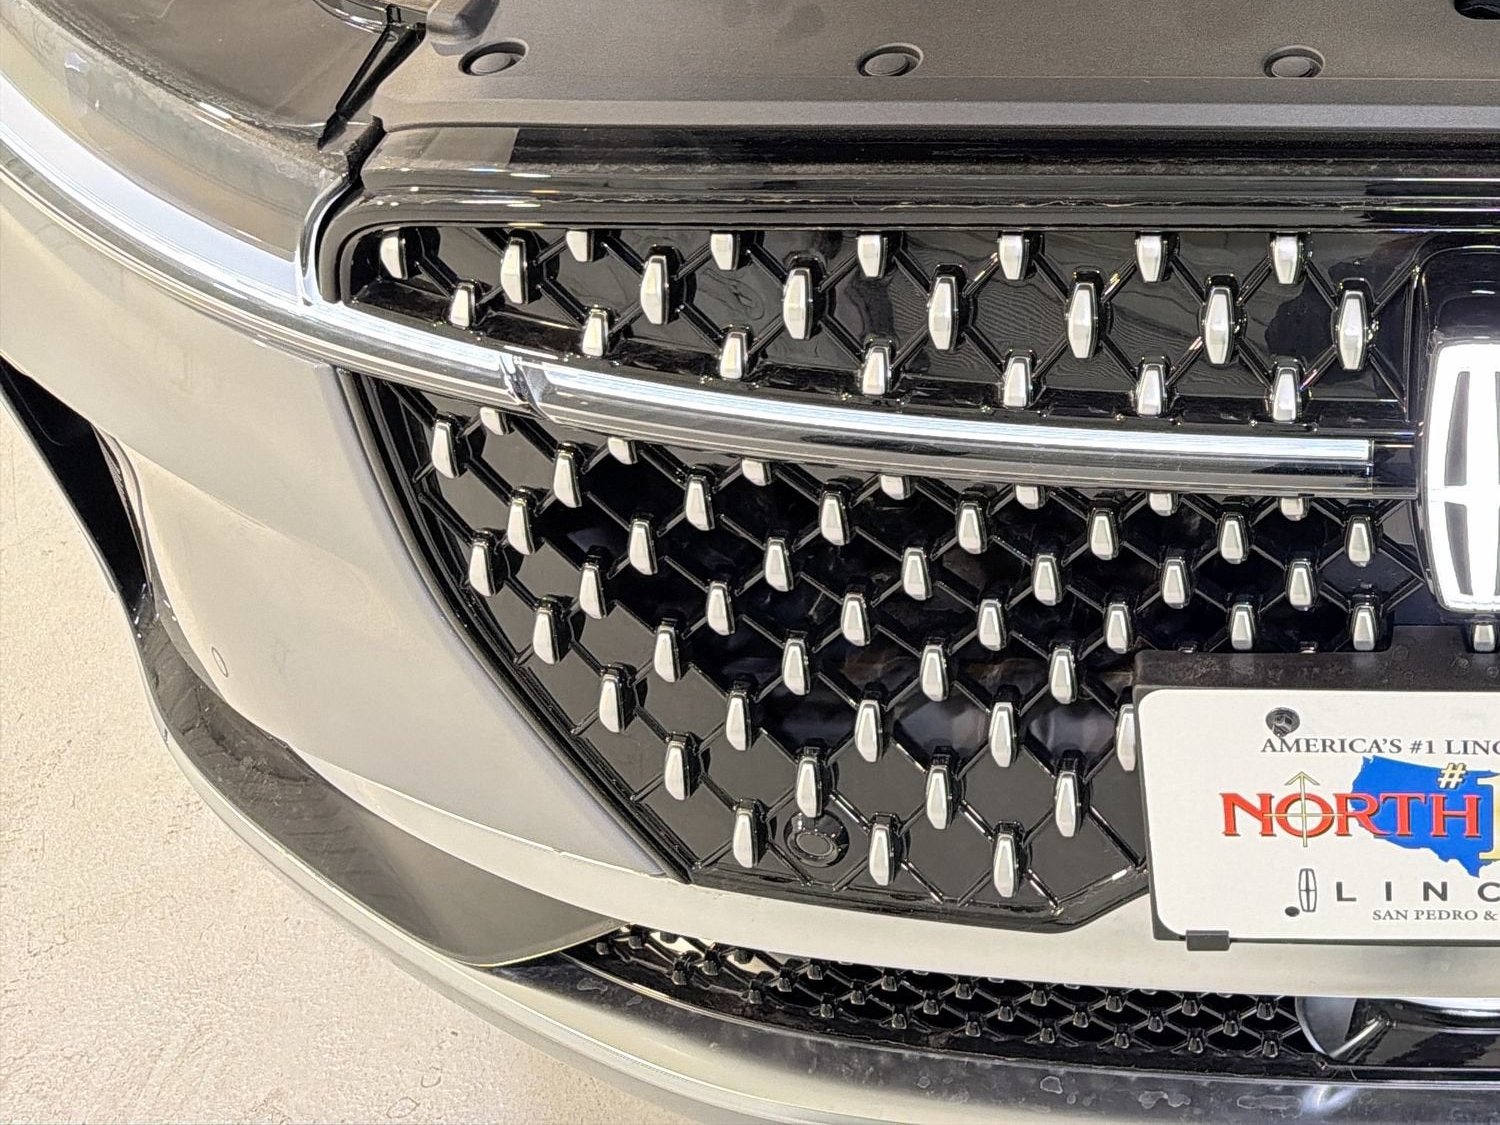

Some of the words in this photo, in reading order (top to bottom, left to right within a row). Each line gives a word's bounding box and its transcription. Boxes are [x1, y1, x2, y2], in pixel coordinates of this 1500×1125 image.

[1409, 738, 1436, 755] #1
[1219, 792, 1482, 838] NORTH
[1371, 909, 1409, 922] SAN
[1413, 909, 1478, 922] PEDRO
[1483, 909, 1499, 922] &
